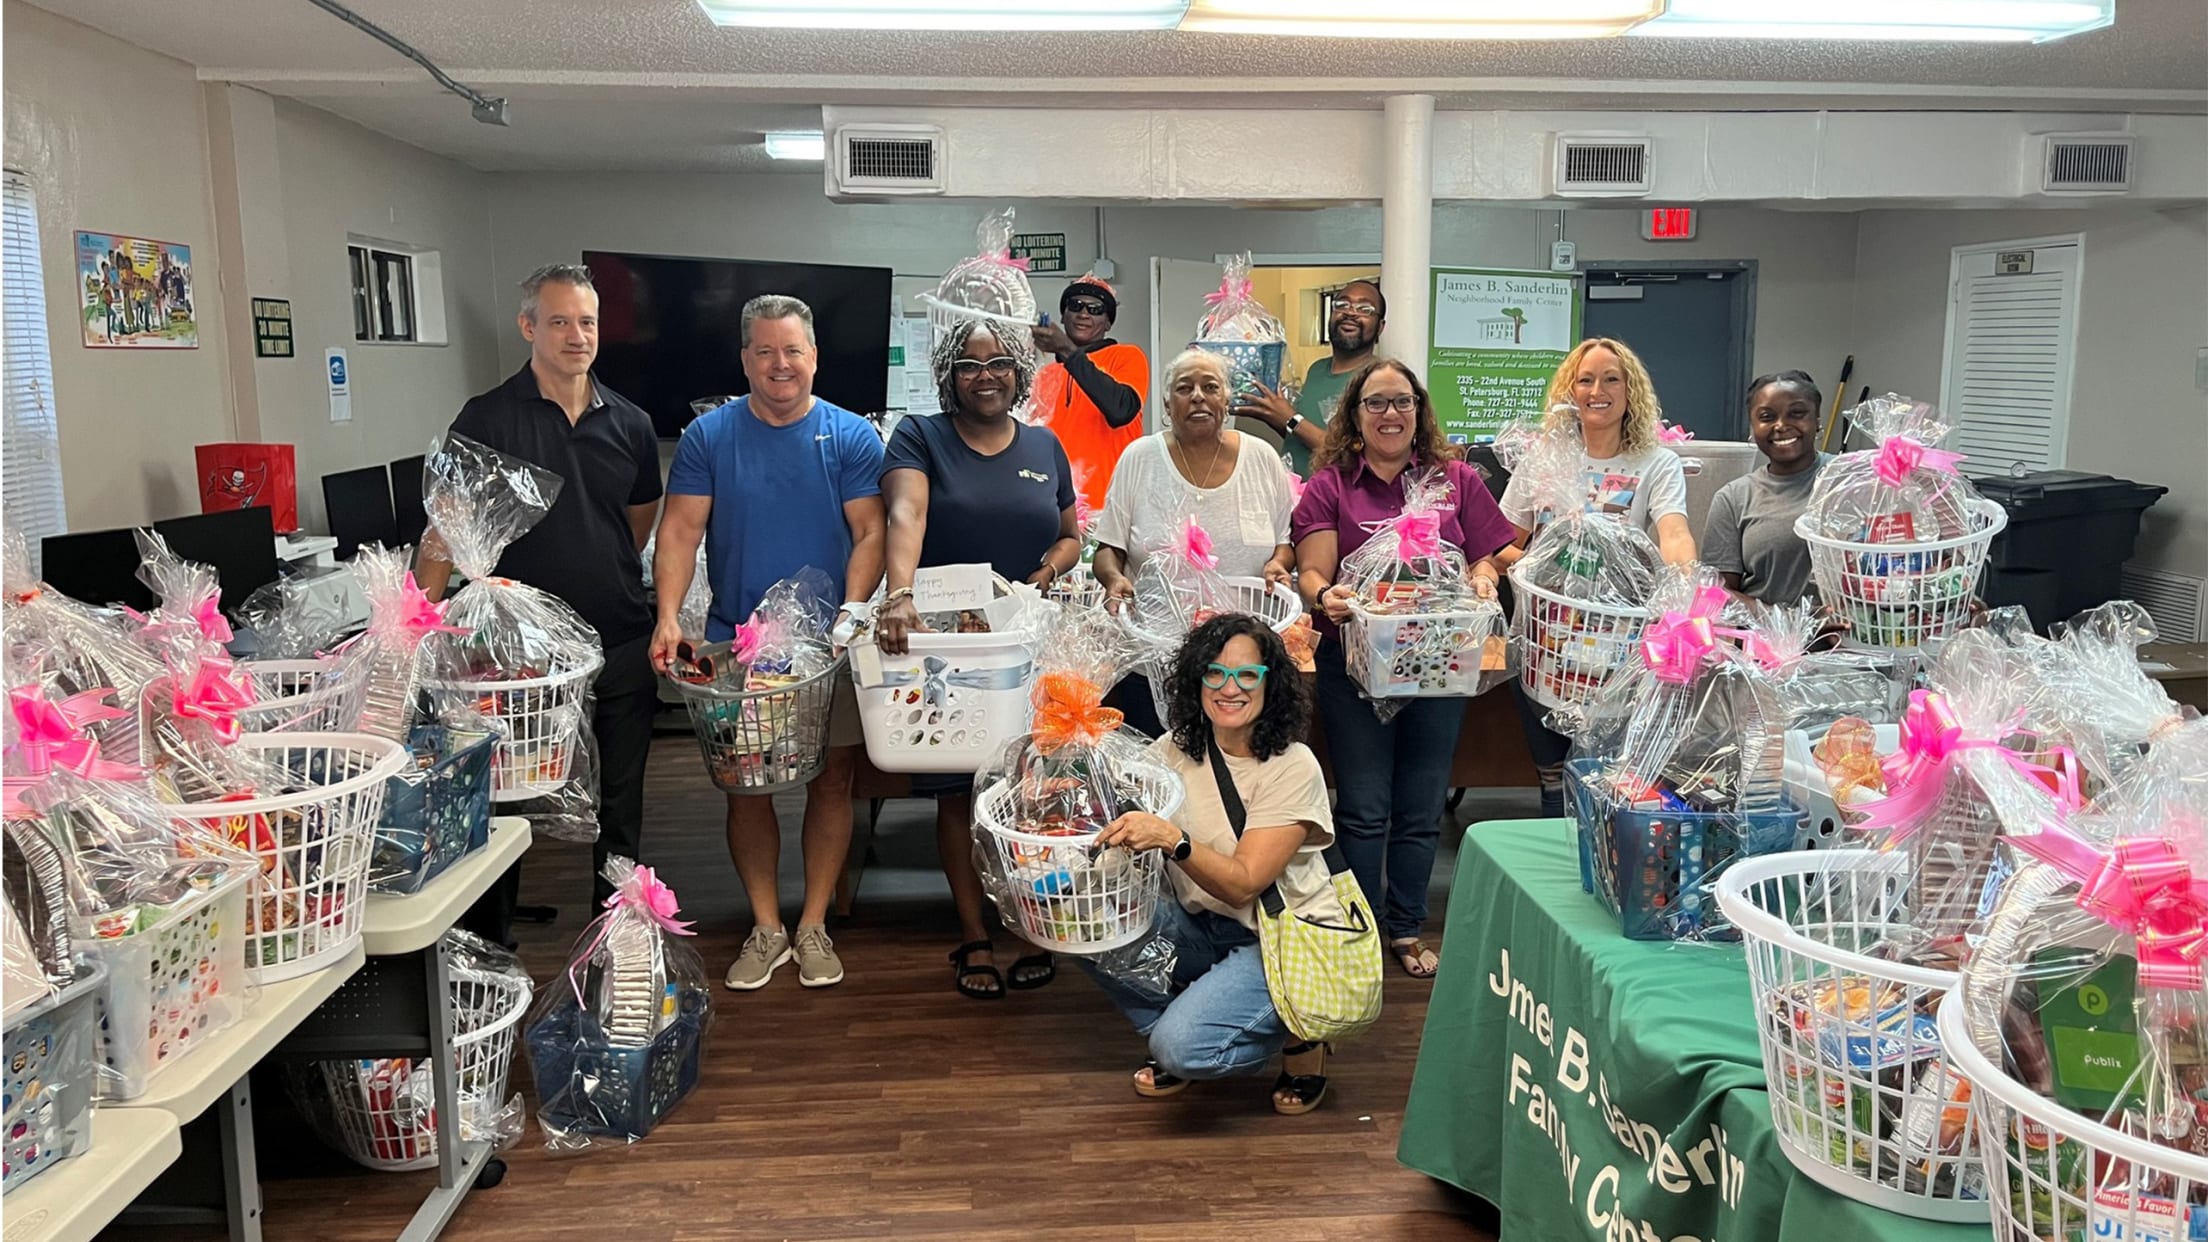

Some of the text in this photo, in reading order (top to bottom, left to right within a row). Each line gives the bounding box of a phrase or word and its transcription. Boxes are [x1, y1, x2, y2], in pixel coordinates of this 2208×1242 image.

[1652, 208, 1690, 238] EXIT
[1023, 235, 1064, 248] LOITERING
[1030, 247, 1061, 259] MINUTE
[1037, 259, 1060, 270] LIMIT
[1440, 278, 1568, 296] James B. Sanderlin
[1447, 294, 1563, 307] Neighborhood Family Center
[1456, 375, 1473, 385] 2335
[1480, 376, 1498, 386] 22nd
[1499, 376, 1525, 387] Avenue
[1525, 377, 1546, 387] South
[1511, 388, 1520, 397] FL
[1521, 388, 1542, 397] 33712
[1557, 1026, 1597, 1107] B.
